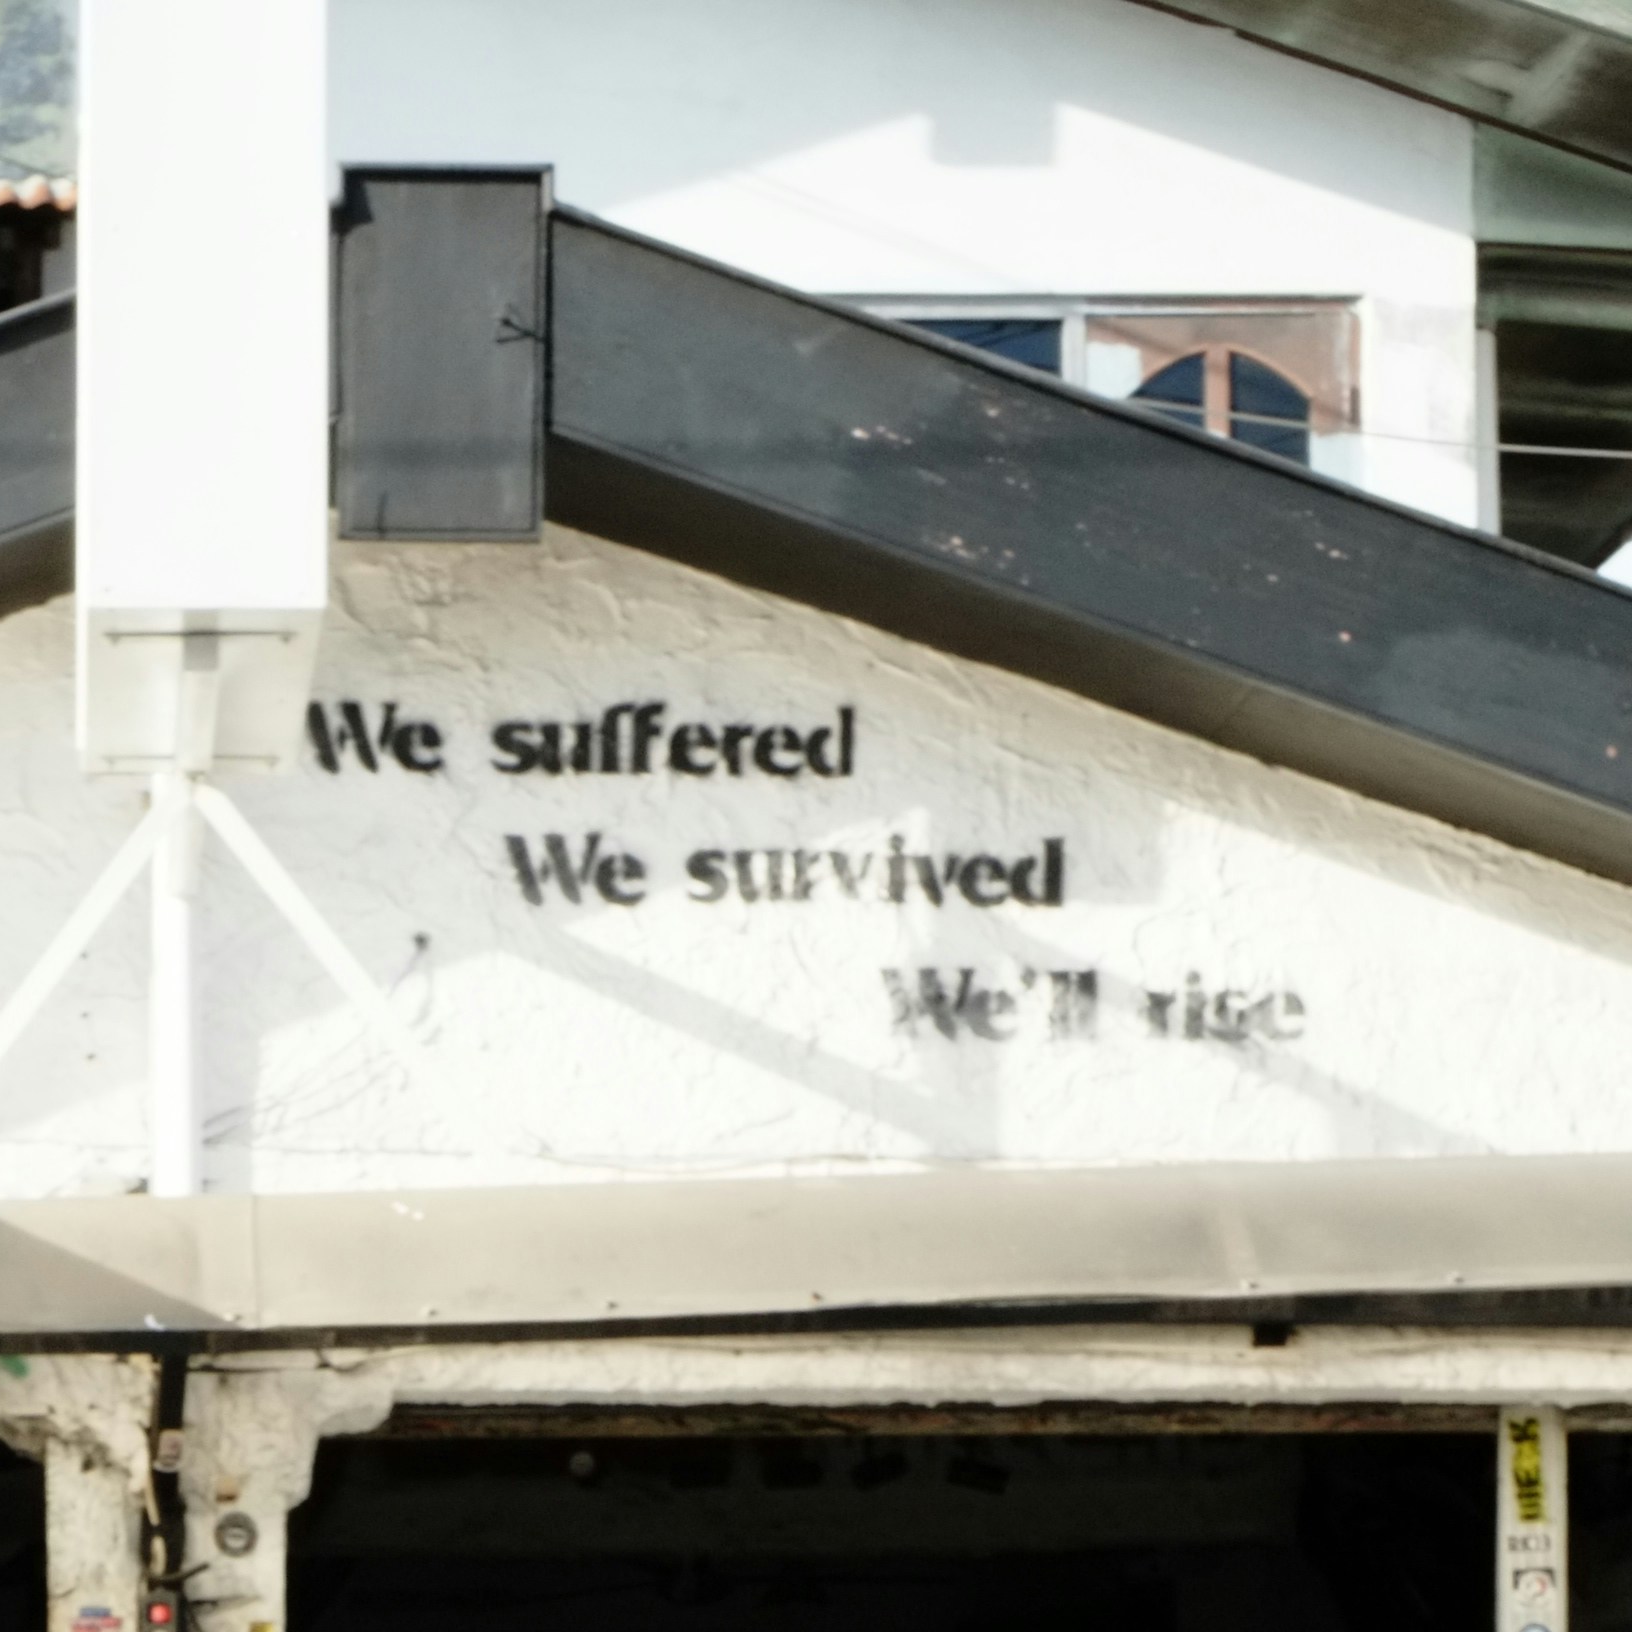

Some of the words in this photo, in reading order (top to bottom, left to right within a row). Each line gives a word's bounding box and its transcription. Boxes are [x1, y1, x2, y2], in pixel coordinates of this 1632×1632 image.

[306, 700, 444, 775] We
[490, 701, 856, 778] suffered
[506, 833, 646, 905] We
[686, 834, 1065, 908] survived
[881, 966, 1098, 1042] We'll
[1148, 970, 1306, 1042] rise
